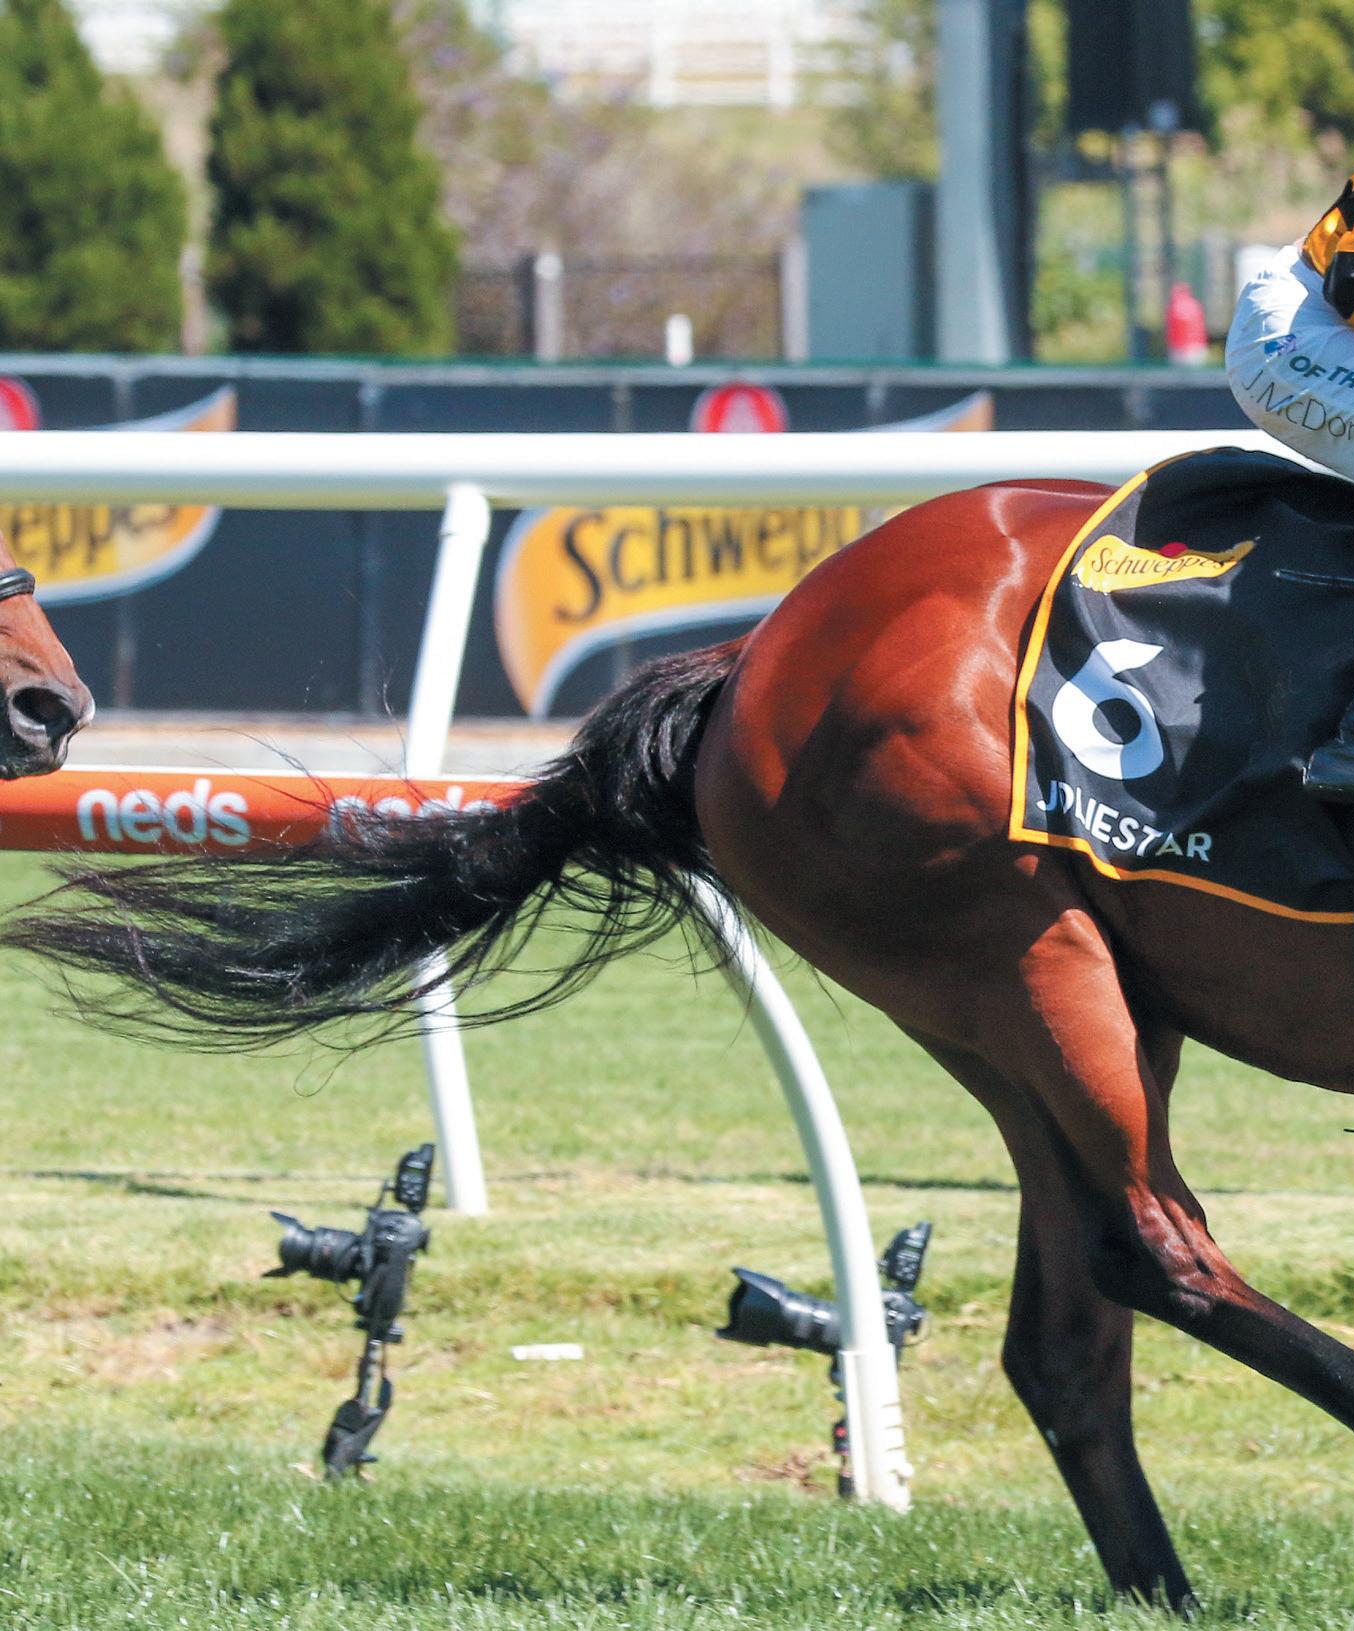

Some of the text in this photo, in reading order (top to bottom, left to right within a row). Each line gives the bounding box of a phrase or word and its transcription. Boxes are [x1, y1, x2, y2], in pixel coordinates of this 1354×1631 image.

[1289, 355, 1327, 378] OF
[1091, 547, 1235, 577] Schweppes
[1052, 638, 1164, 780] 6
[77, 778, 251, 847] neds
